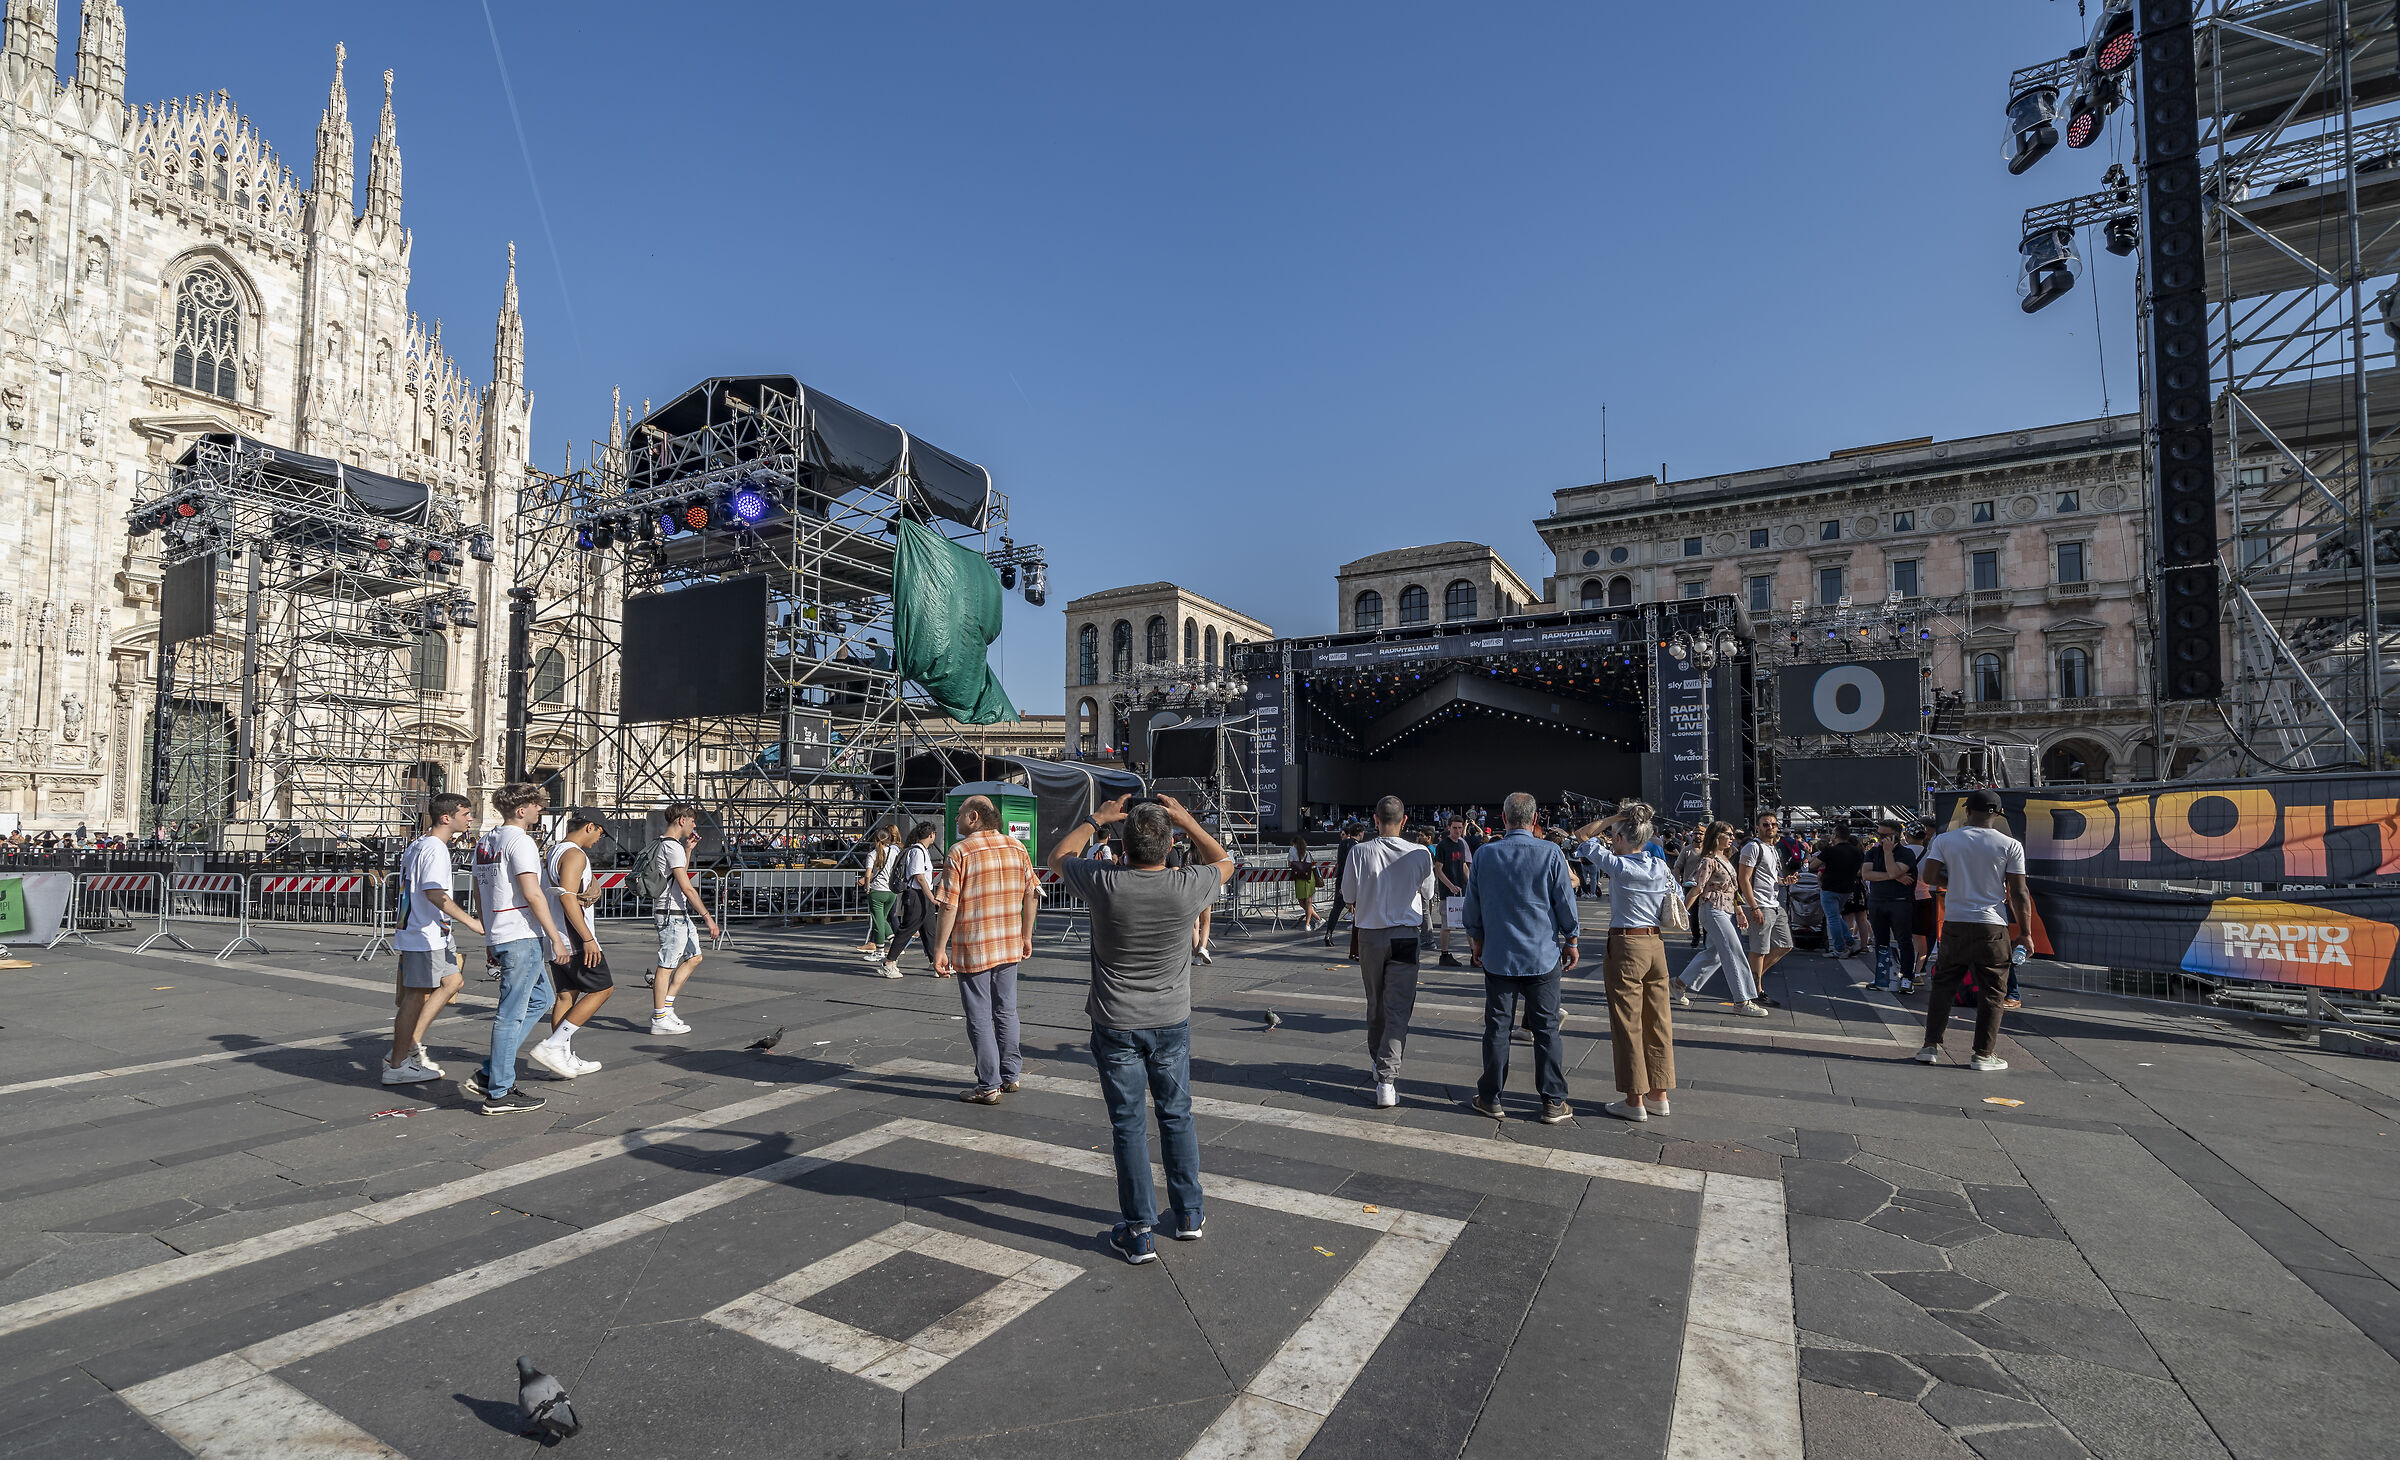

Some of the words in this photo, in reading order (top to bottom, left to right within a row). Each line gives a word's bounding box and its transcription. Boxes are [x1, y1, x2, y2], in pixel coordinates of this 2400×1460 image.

[1469, 640, 1481, 648] sky
[1668, 680, 1682, 690] sky
[1812, 665, 1885, 733] O
[1677, 722, 1703, 731] LIVE
[2221, 922, 2350, 944] RADIO
[2224, 941, 2352, 966] ITALIA
